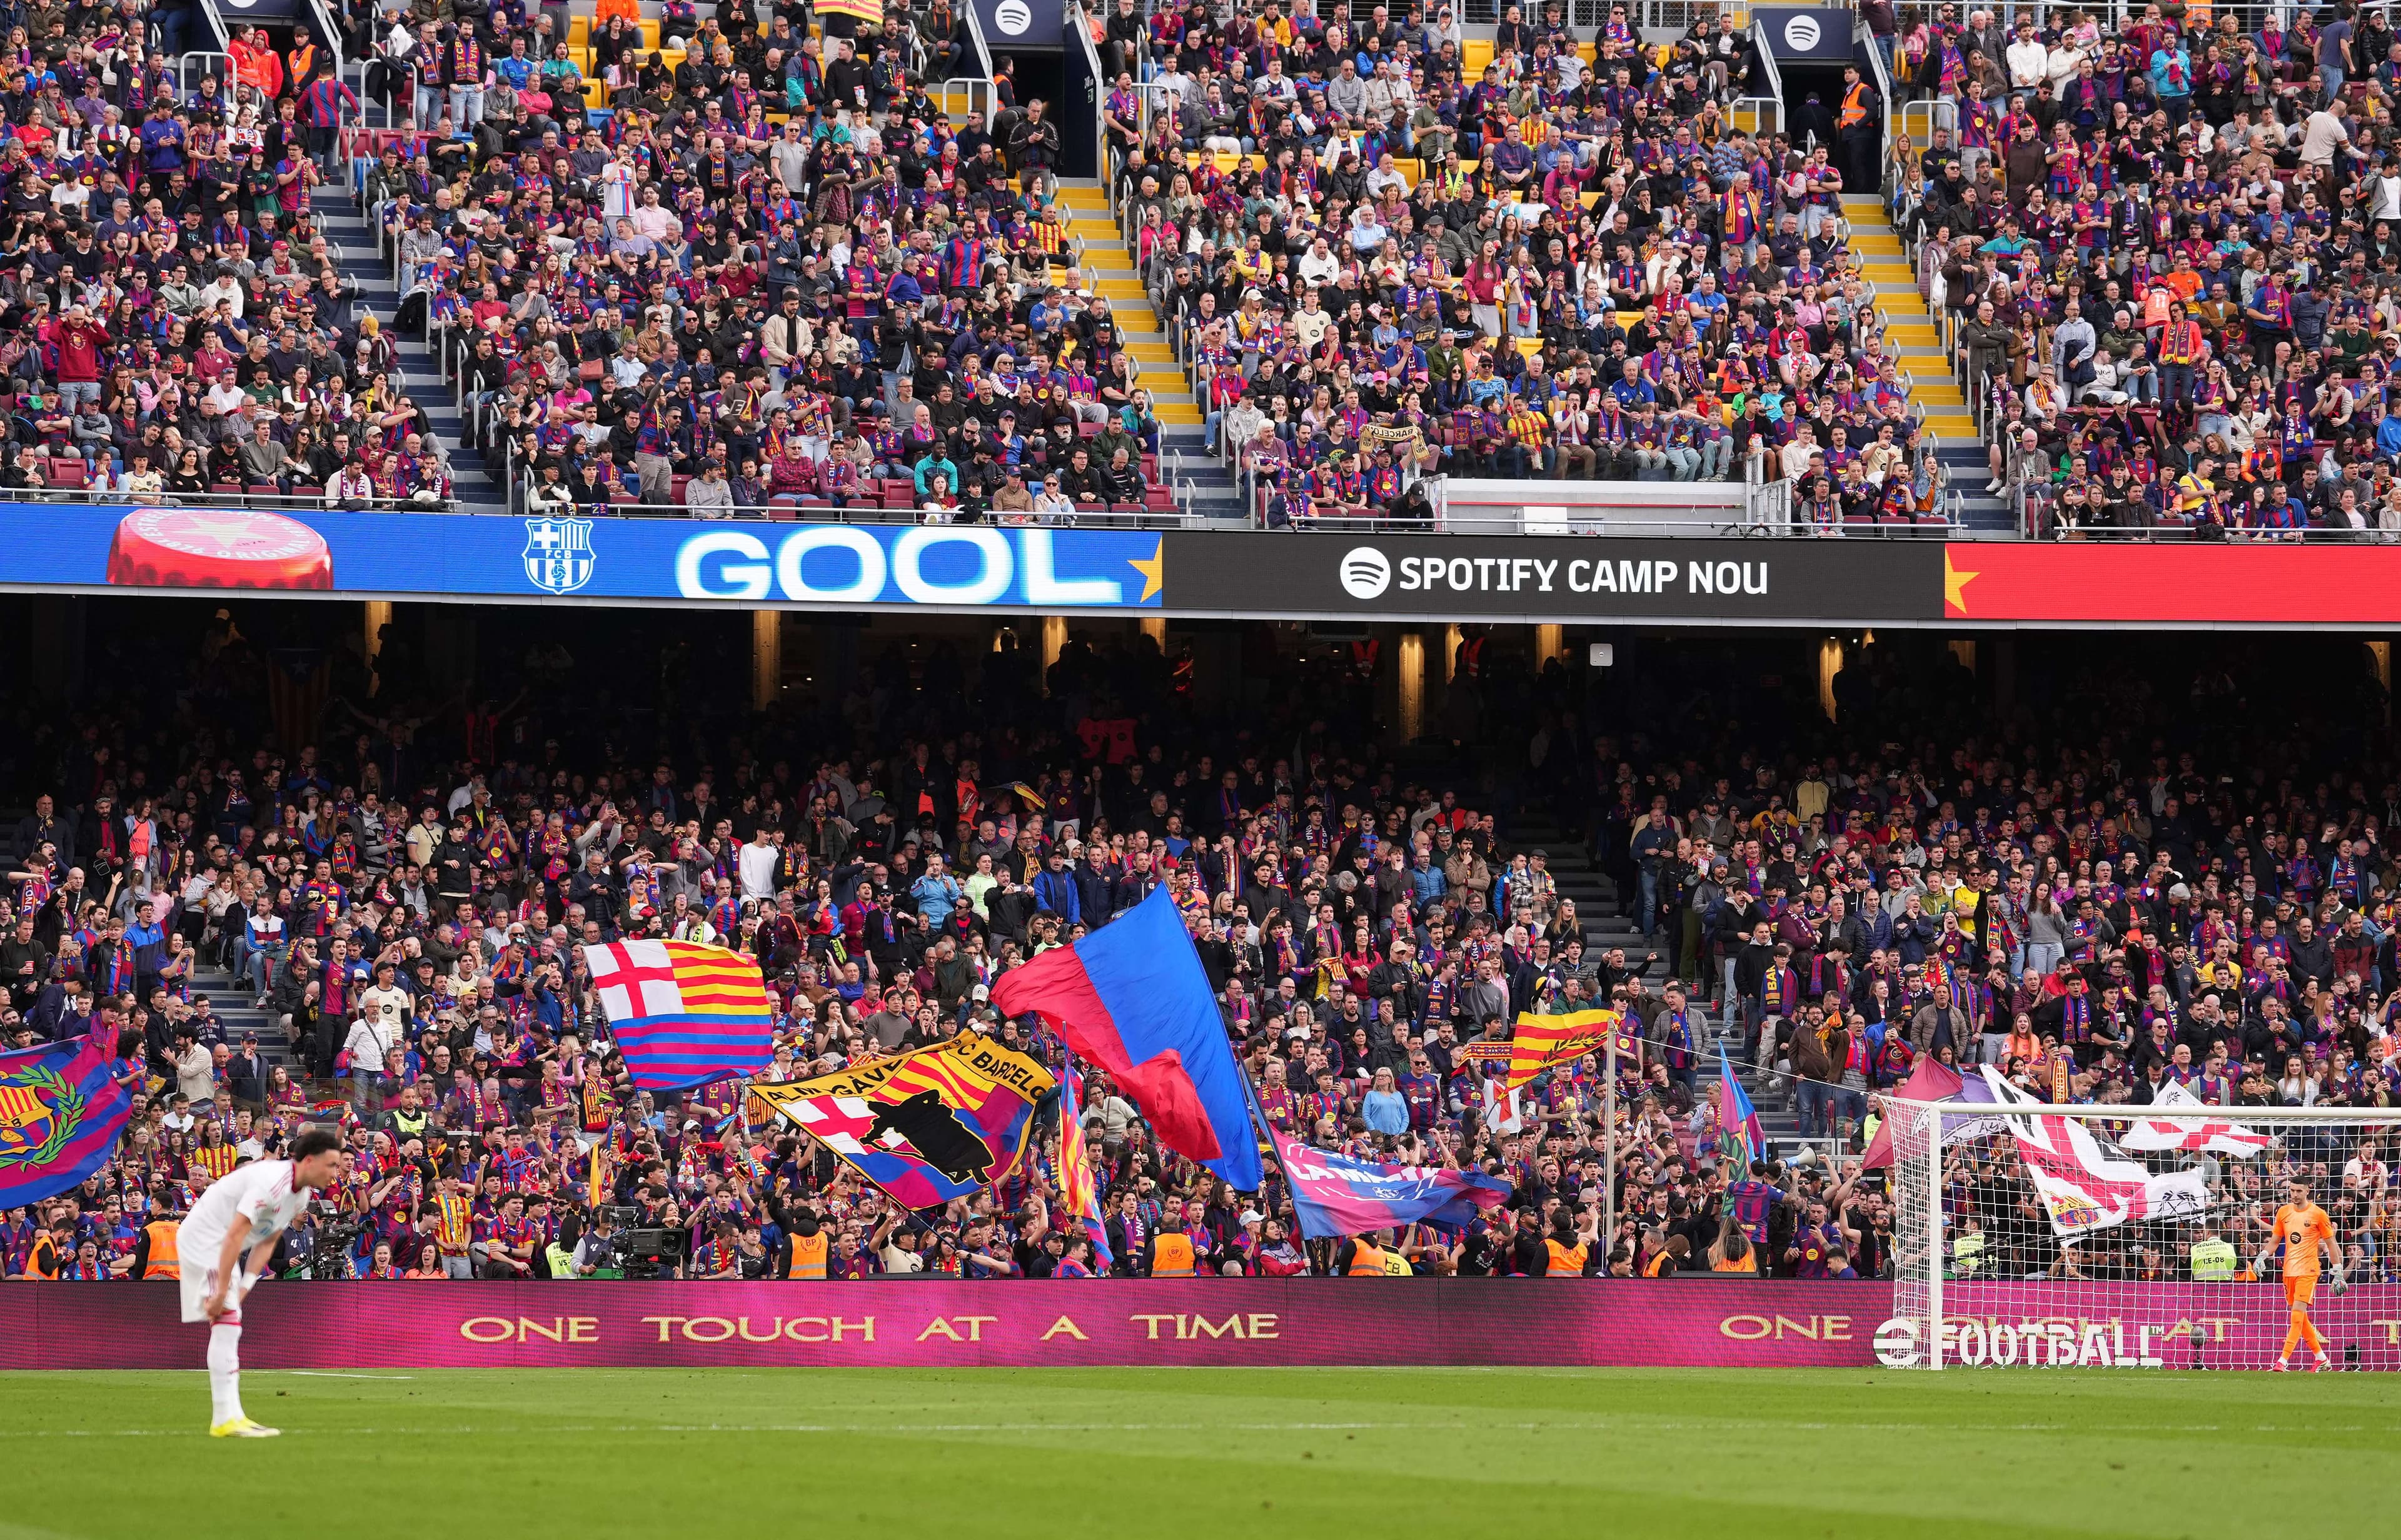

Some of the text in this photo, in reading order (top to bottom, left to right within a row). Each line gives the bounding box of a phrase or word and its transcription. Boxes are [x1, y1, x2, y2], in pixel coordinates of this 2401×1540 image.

[1416, 331, 1436, 342] UFC
[545, 550, 570, 559] FCB
[675, 526, 1124, 605] GOOL
[1399, 556, 1768, 595] SPOTIFY CAMP NOU
[807, 1239, 817, 1247] BP
[460, 1313, 1279, 1342] ONE TOUCH AT A TIME
[1719, 1315, 1852, 1341] ONE
